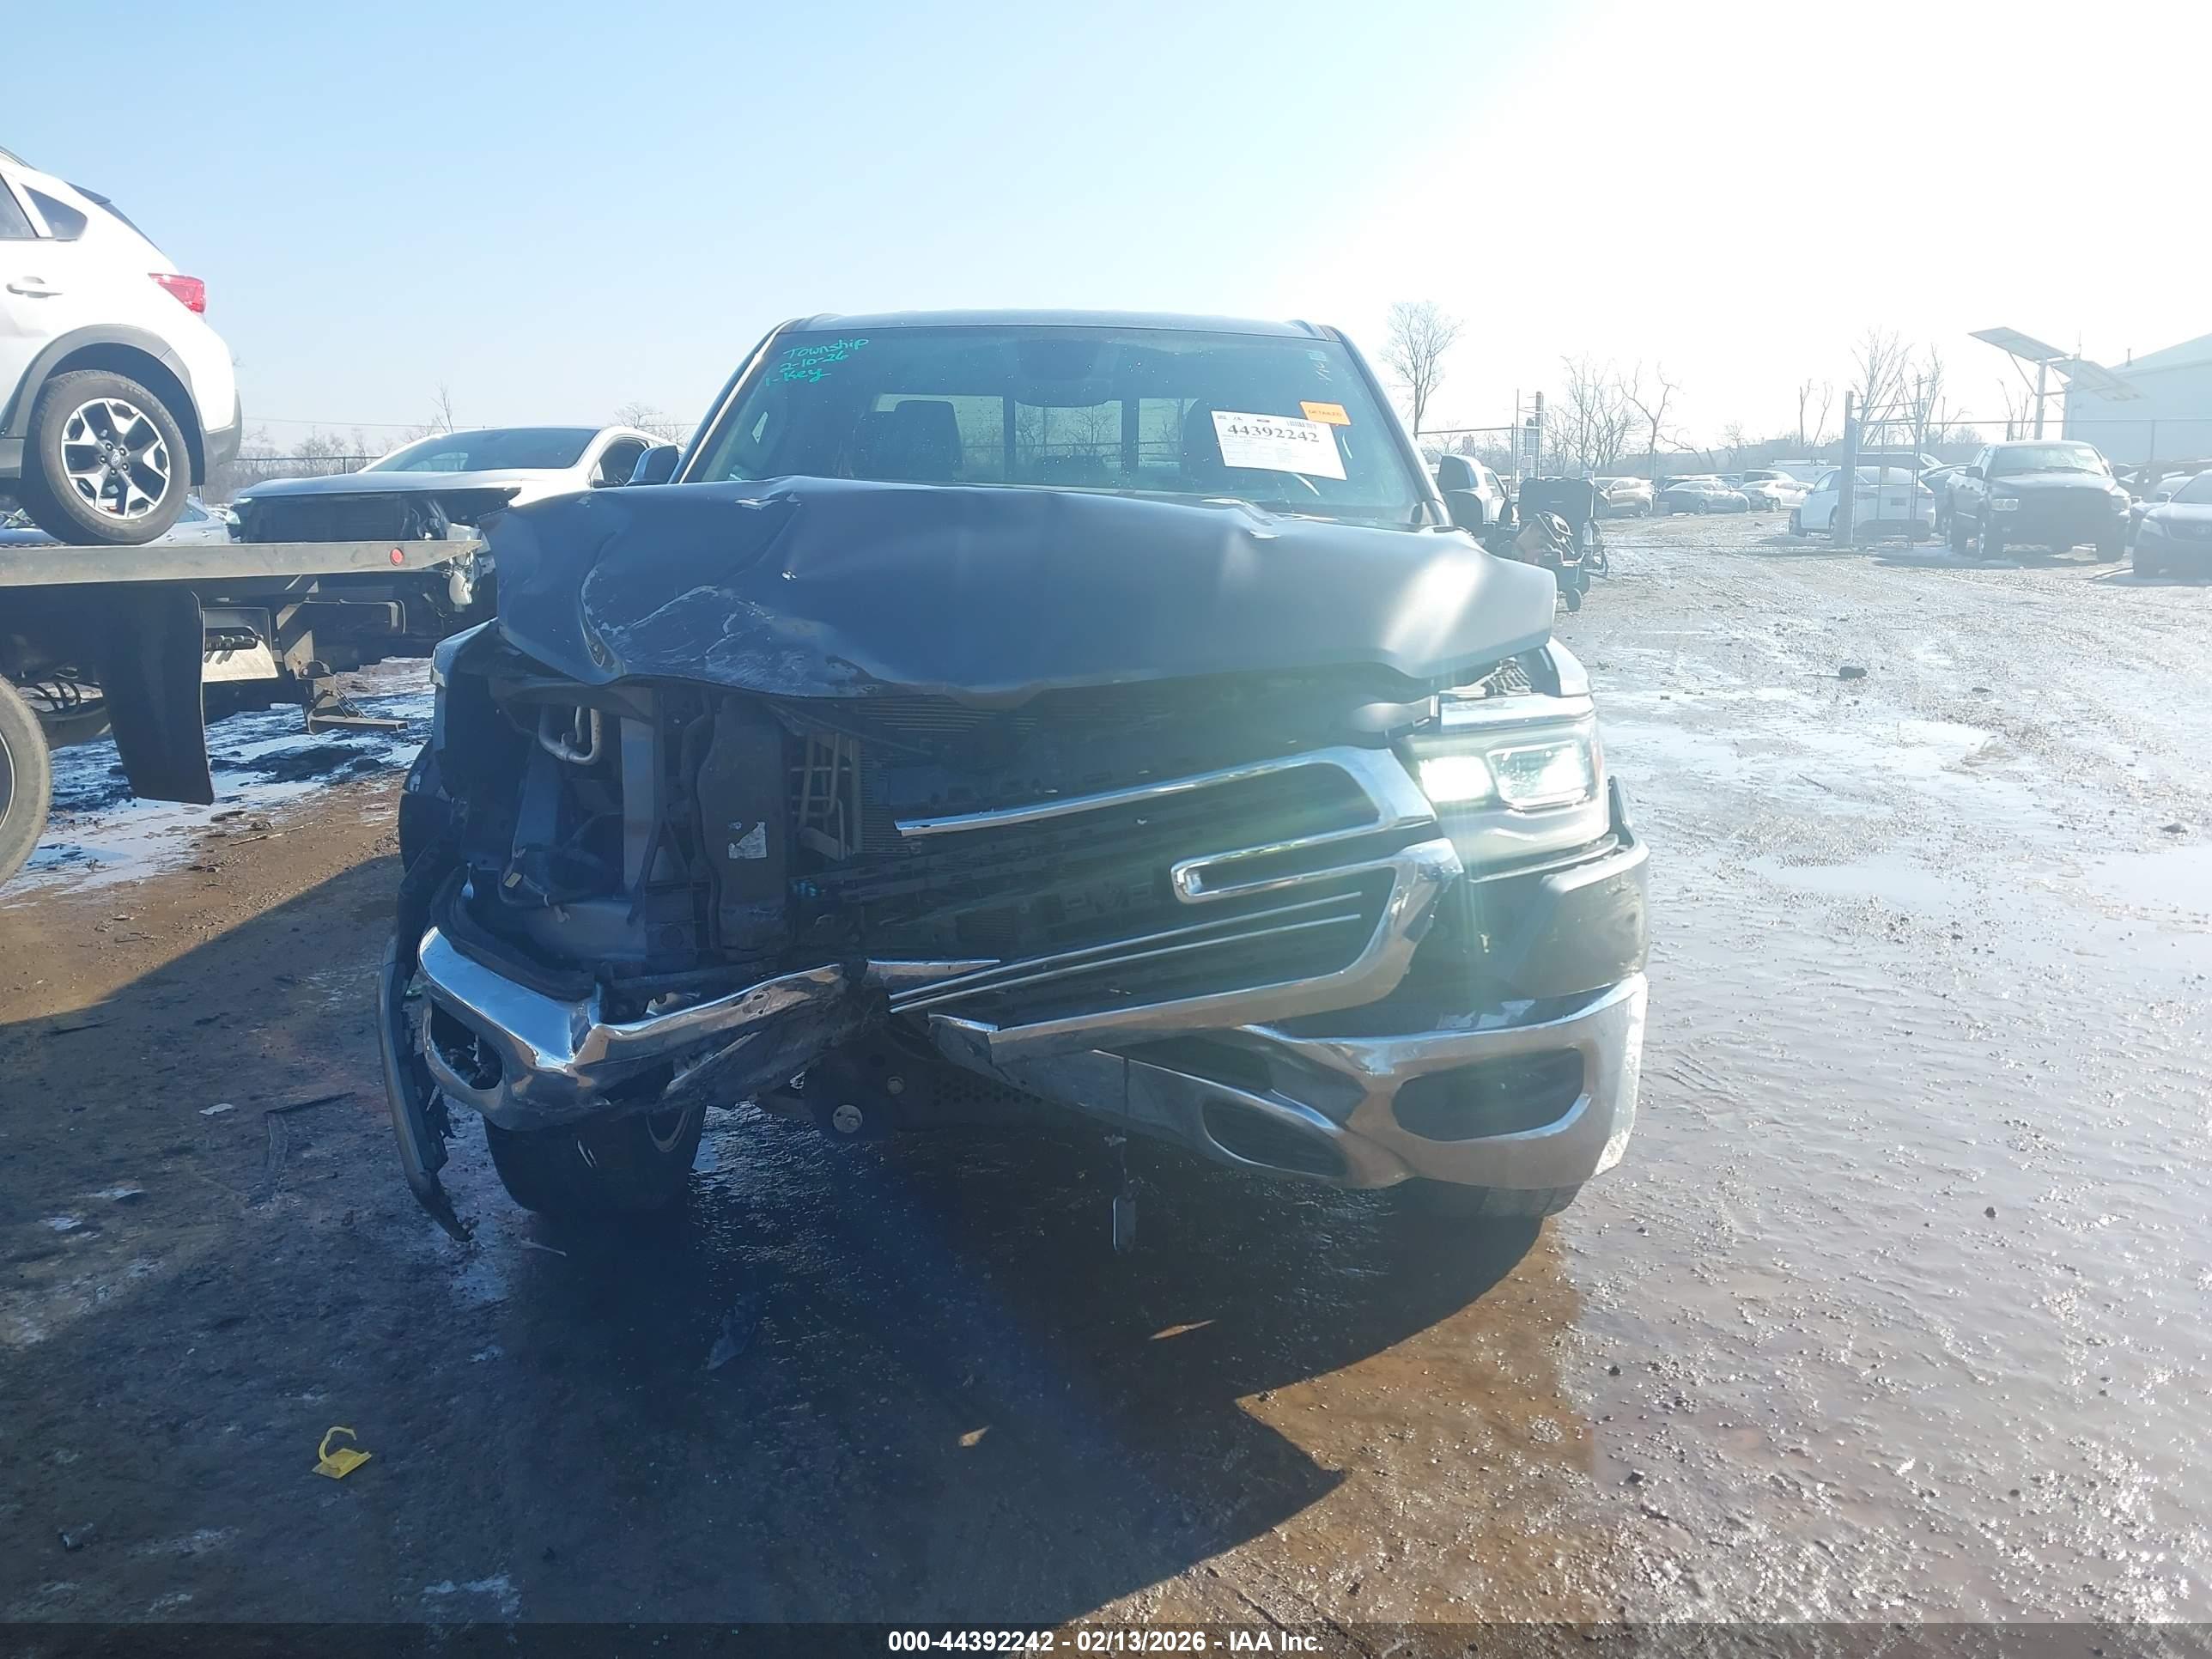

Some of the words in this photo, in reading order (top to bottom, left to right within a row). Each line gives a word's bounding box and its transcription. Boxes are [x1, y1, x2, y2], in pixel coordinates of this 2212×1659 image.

[783, 338, 869, 358] Township
[780, 350, 849, 373] 2-10-26
[1227, 424, 1320, 443] 44392242
